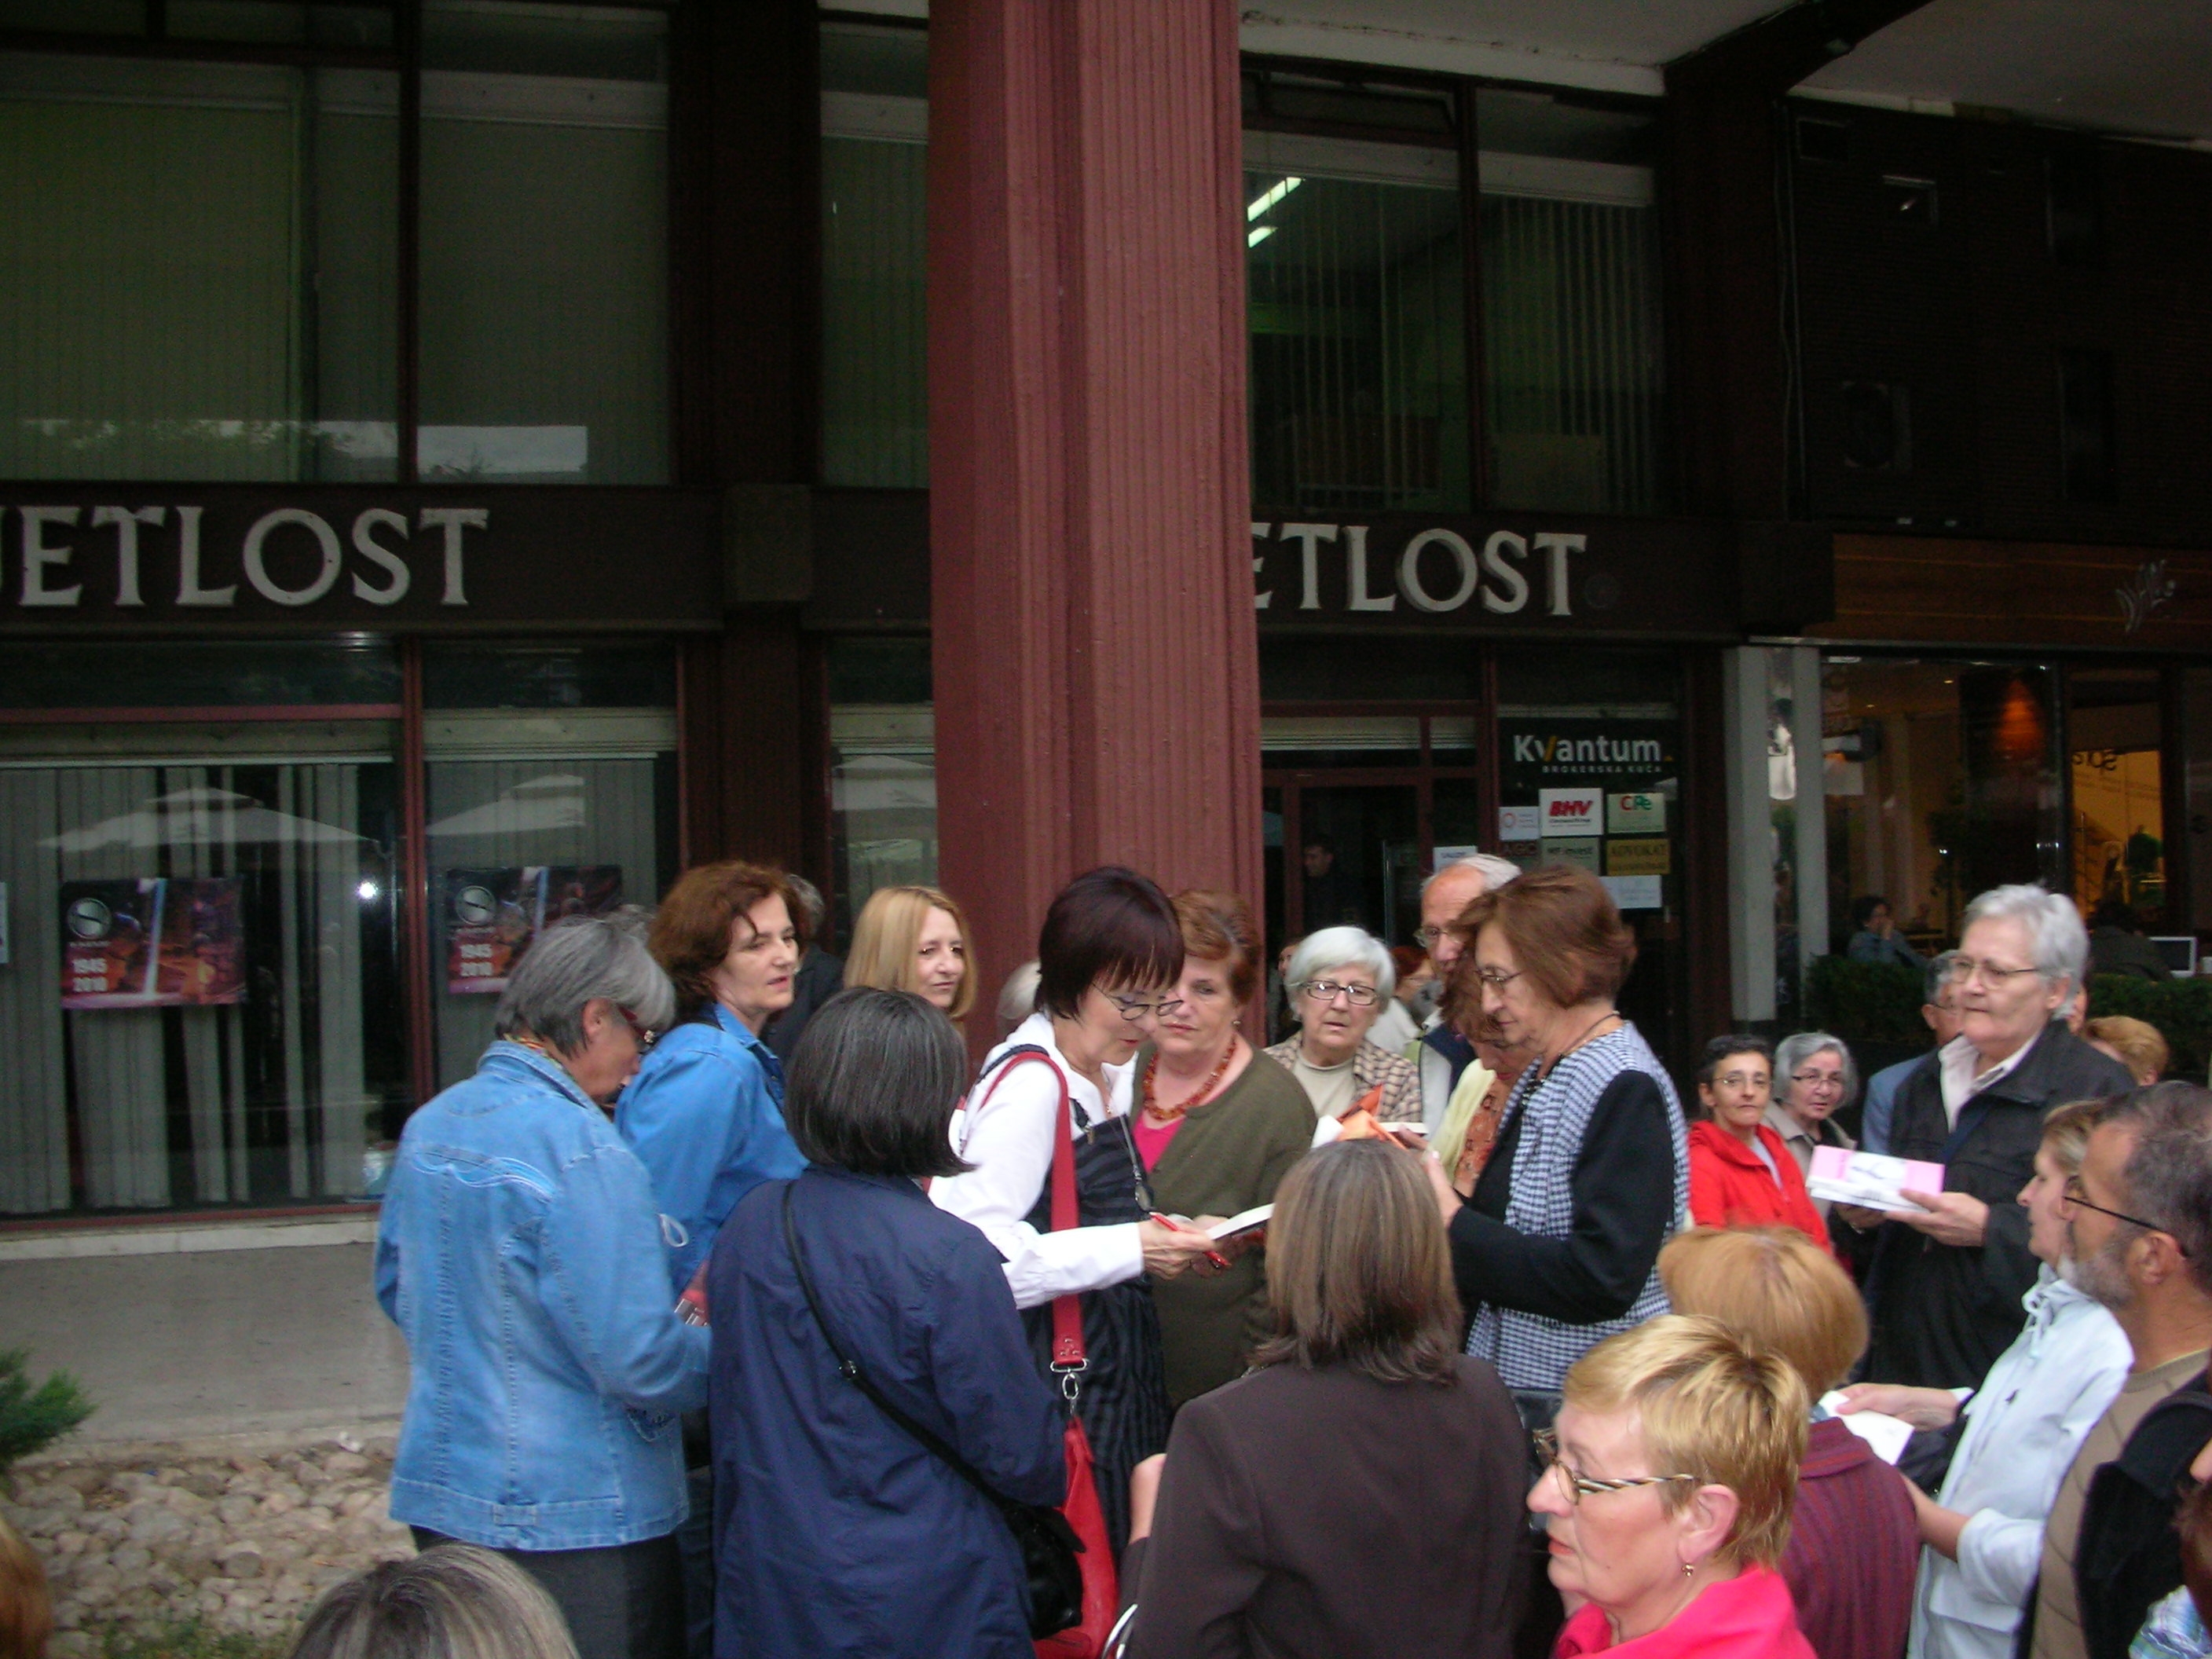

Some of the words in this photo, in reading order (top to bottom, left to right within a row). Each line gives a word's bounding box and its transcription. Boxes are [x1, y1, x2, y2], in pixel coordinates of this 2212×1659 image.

[0, 506, 490, 606] ETLOST
[1542, 765, 1623, 774] BROKERSKA
[1549, 800, 1594, 817] BHV
